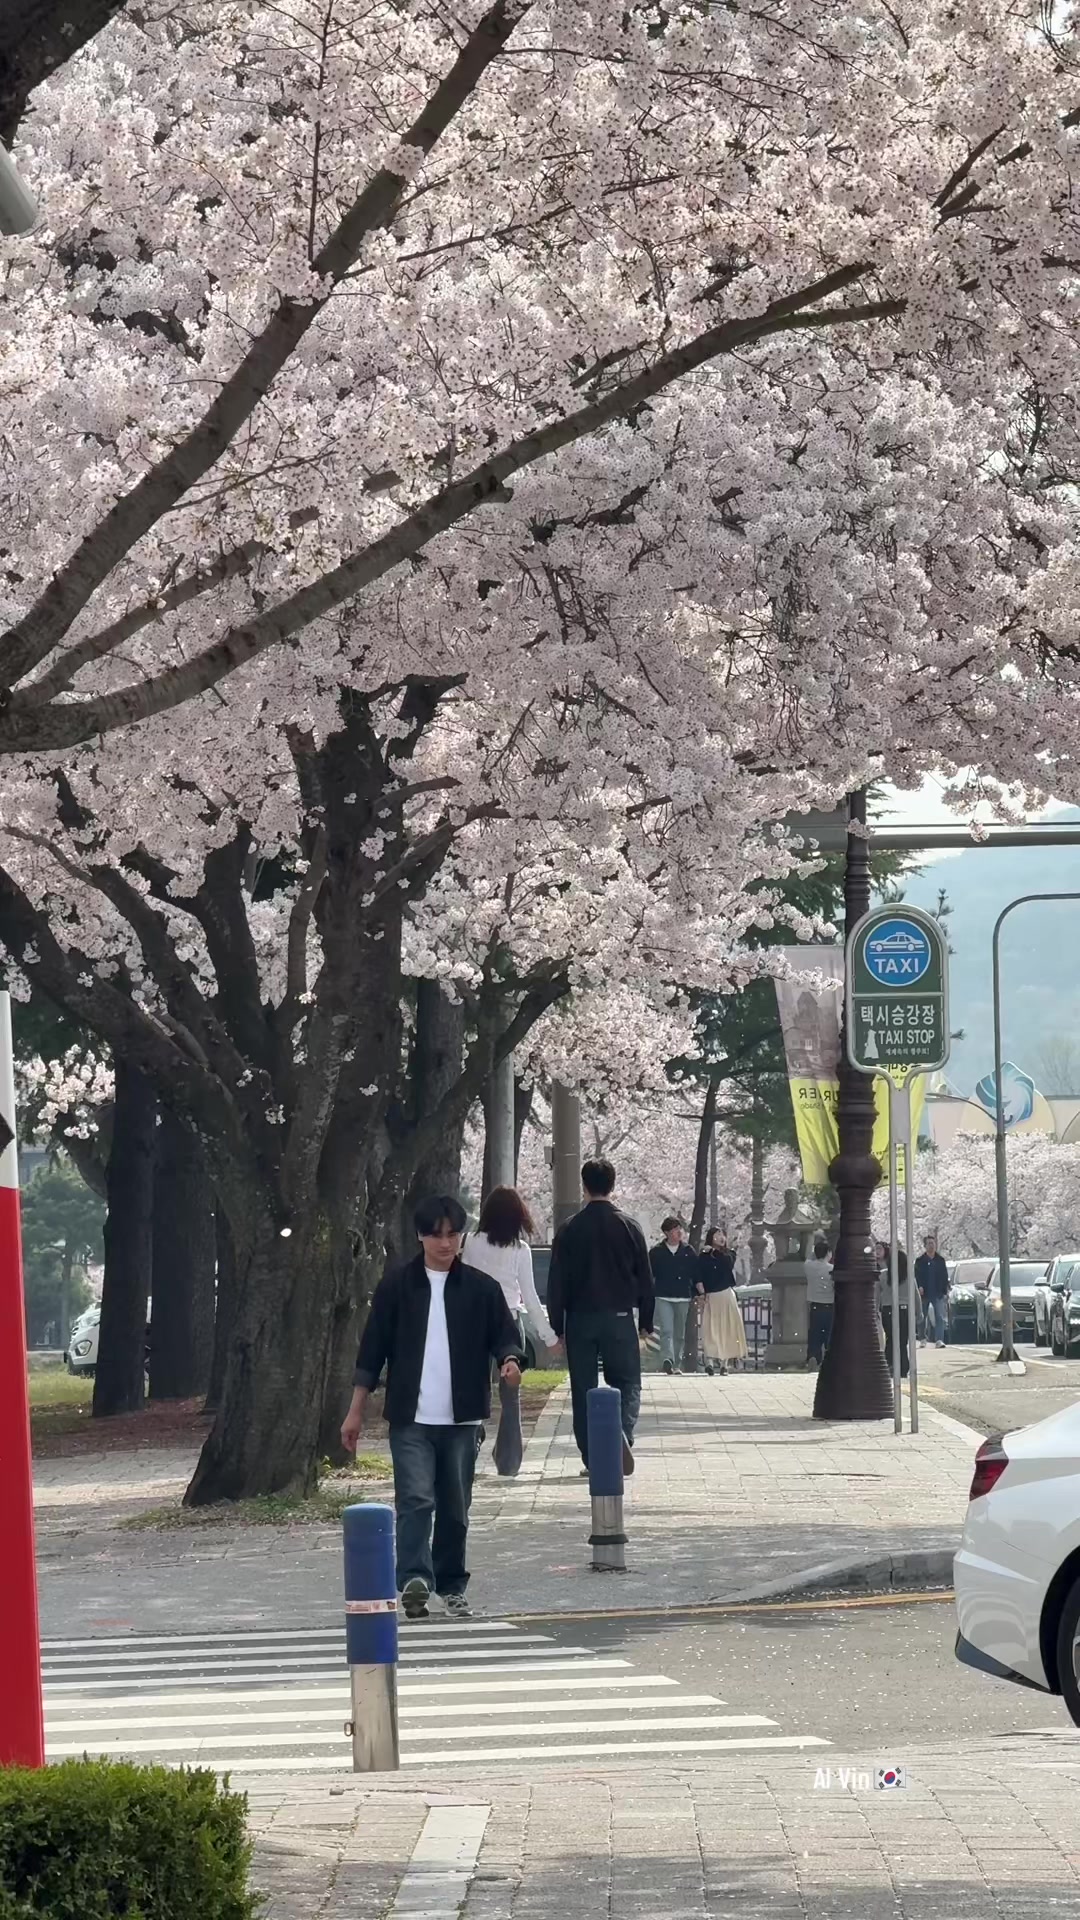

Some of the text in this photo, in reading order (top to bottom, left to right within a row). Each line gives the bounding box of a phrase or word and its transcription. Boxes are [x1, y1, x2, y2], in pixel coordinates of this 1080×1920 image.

[874, 958, 919, 974] TAXI
[861, 1004, 935, 1026] 택시승강장
[878, 1029, 935, 1045] TAXI STOP
